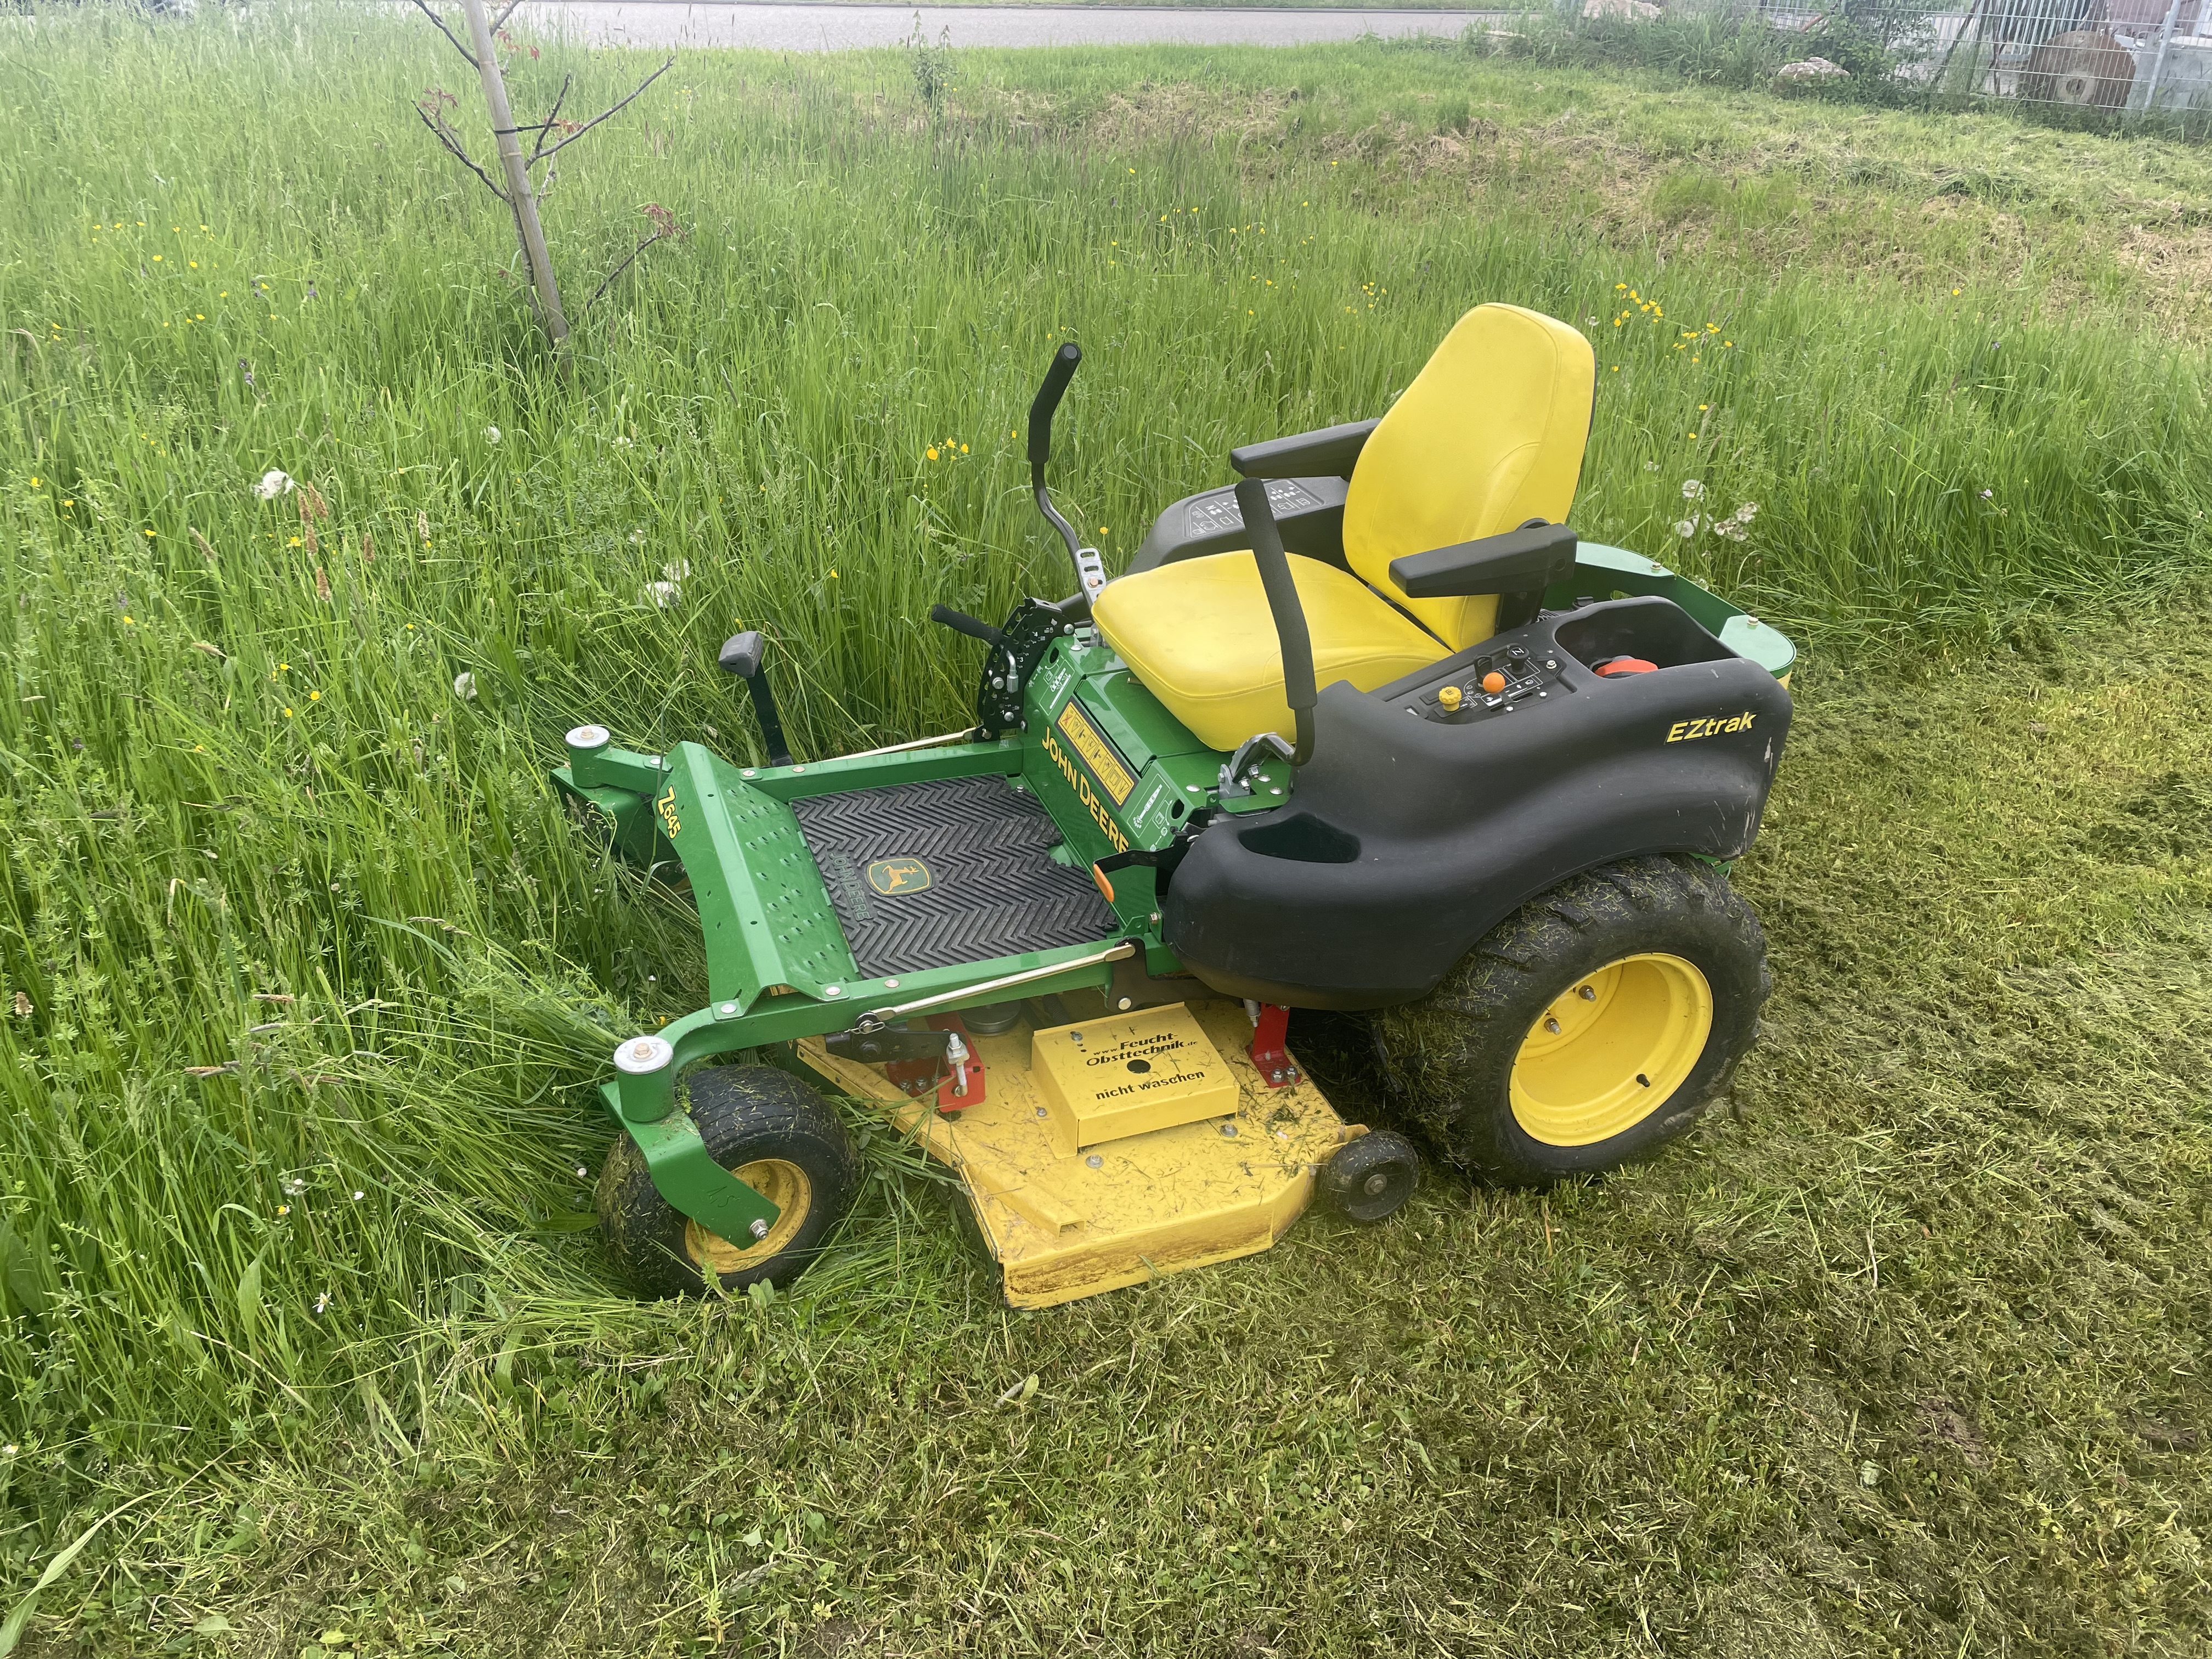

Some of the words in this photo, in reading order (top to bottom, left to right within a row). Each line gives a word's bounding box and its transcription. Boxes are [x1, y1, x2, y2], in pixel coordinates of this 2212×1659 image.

[1666, 711, 1757, 743] EZtrak
[658, 784, 682, 839] Z645
[1042, 726, 1077, 791] JOHN
[1080, 772, 1130, 854] DEERE
[828, 853, 857, 883] JOHN
[844, 880, 872, 921] DEERE
[1086, 1040, 1198, 1066] Obsttechnik.de
[1096, 1084, 1135, 1100] nicht
[1137, 1071, 1206, 1091] waschen
